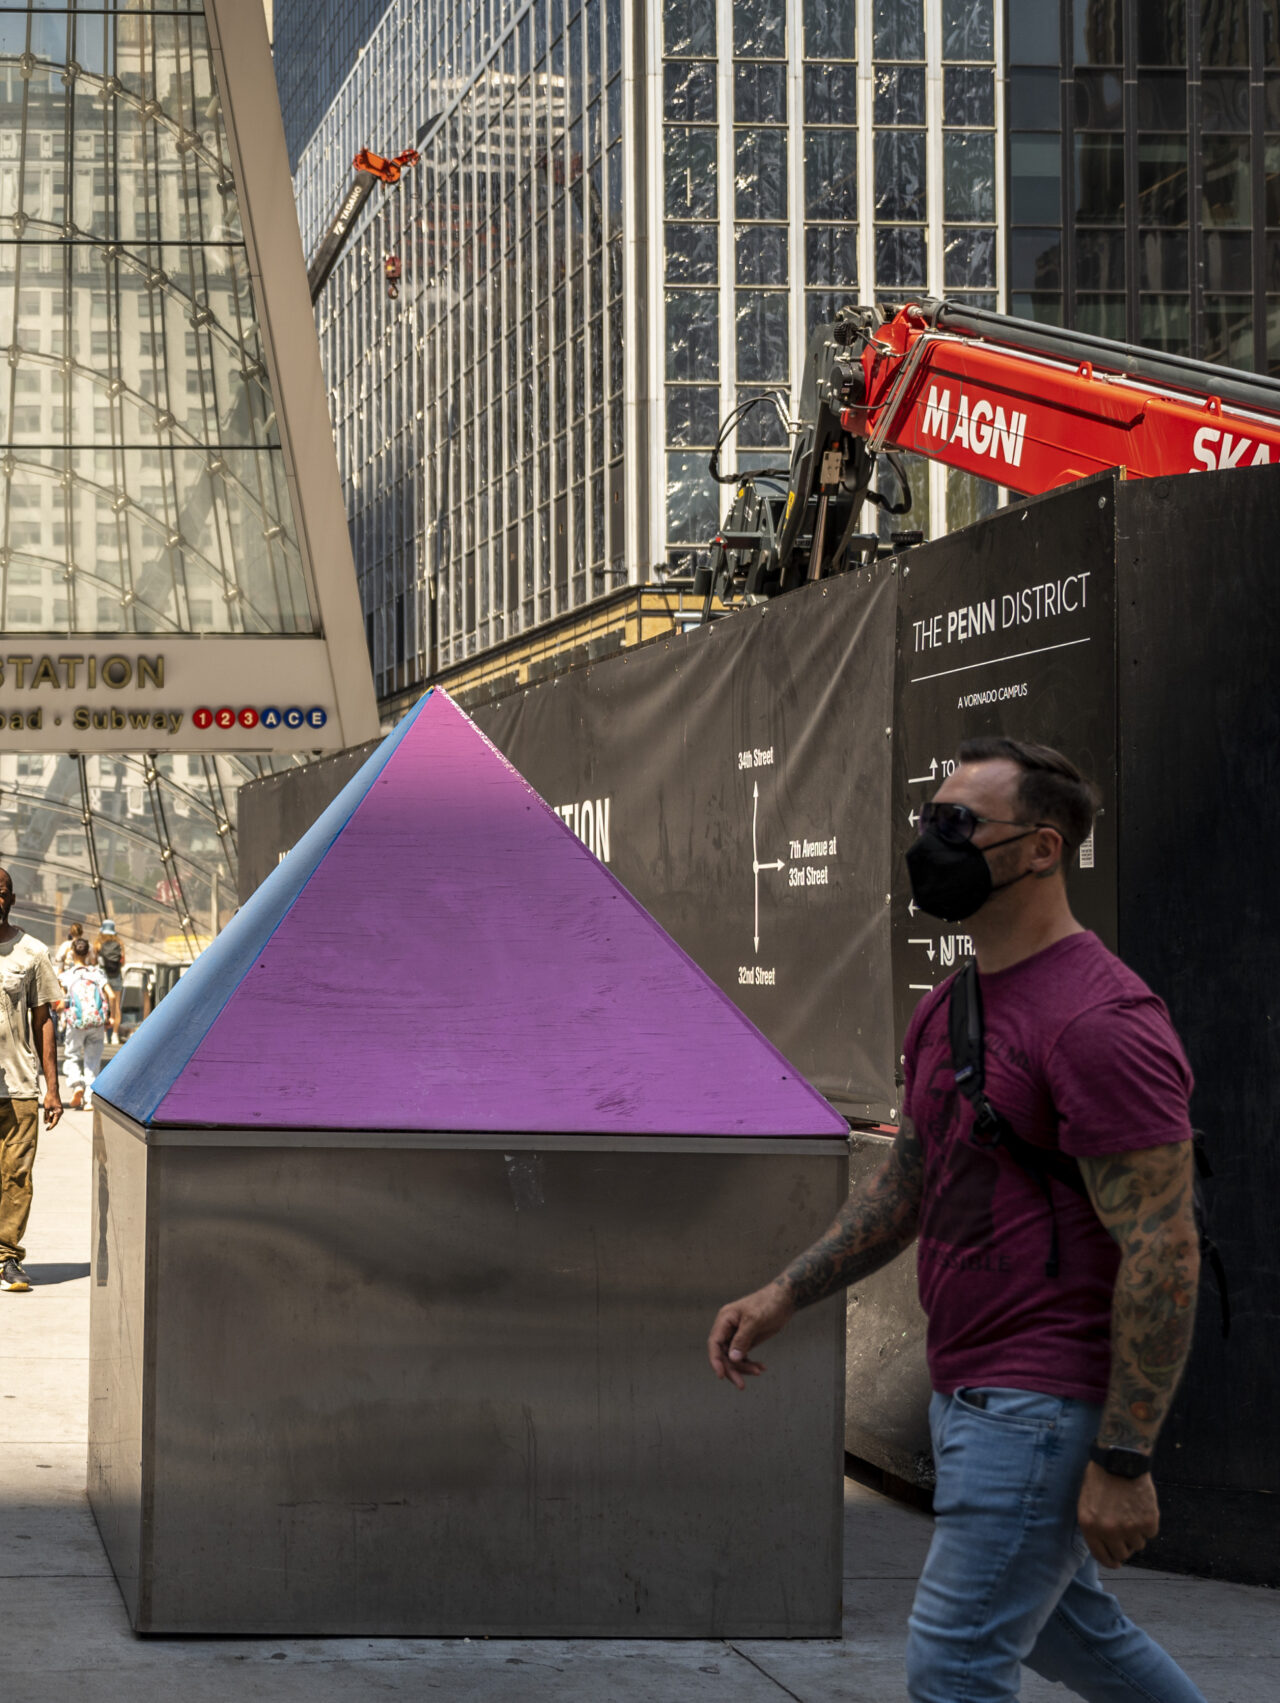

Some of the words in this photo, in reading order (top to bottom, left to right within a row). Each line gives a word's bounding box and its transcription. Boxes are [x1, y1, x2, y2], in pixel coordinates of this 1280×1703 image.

[340, 185, 363, 220] TADANO
[921, 384, 1028, 468] MAGNI
[912, 614, 943, 652] THE
[947, 598, 996, 643] PENN
[1002, 571, 1091, 629] DISTRICT
[957, 696, 964, 710] A
[963, 689, 997, 708] VORNADO
[998, 682, 1028, 701] CAMPUS
[72, 707, 184, 735] Subway
[738, 750, 753, 770] 34th
[753, 746, 774, 767] Street
[941, 759, 956, 778] TO
[789, 840, 801, 859] 7th
[802, 839, 828, 857] Avenue
[828, 836, 837, 855] at
[789, 867, 805, 887] 33rd
[806, 866, 828, 885] Street
[738, 966, 755, 985] 32nd
[755, 966, 775, 985] Street
